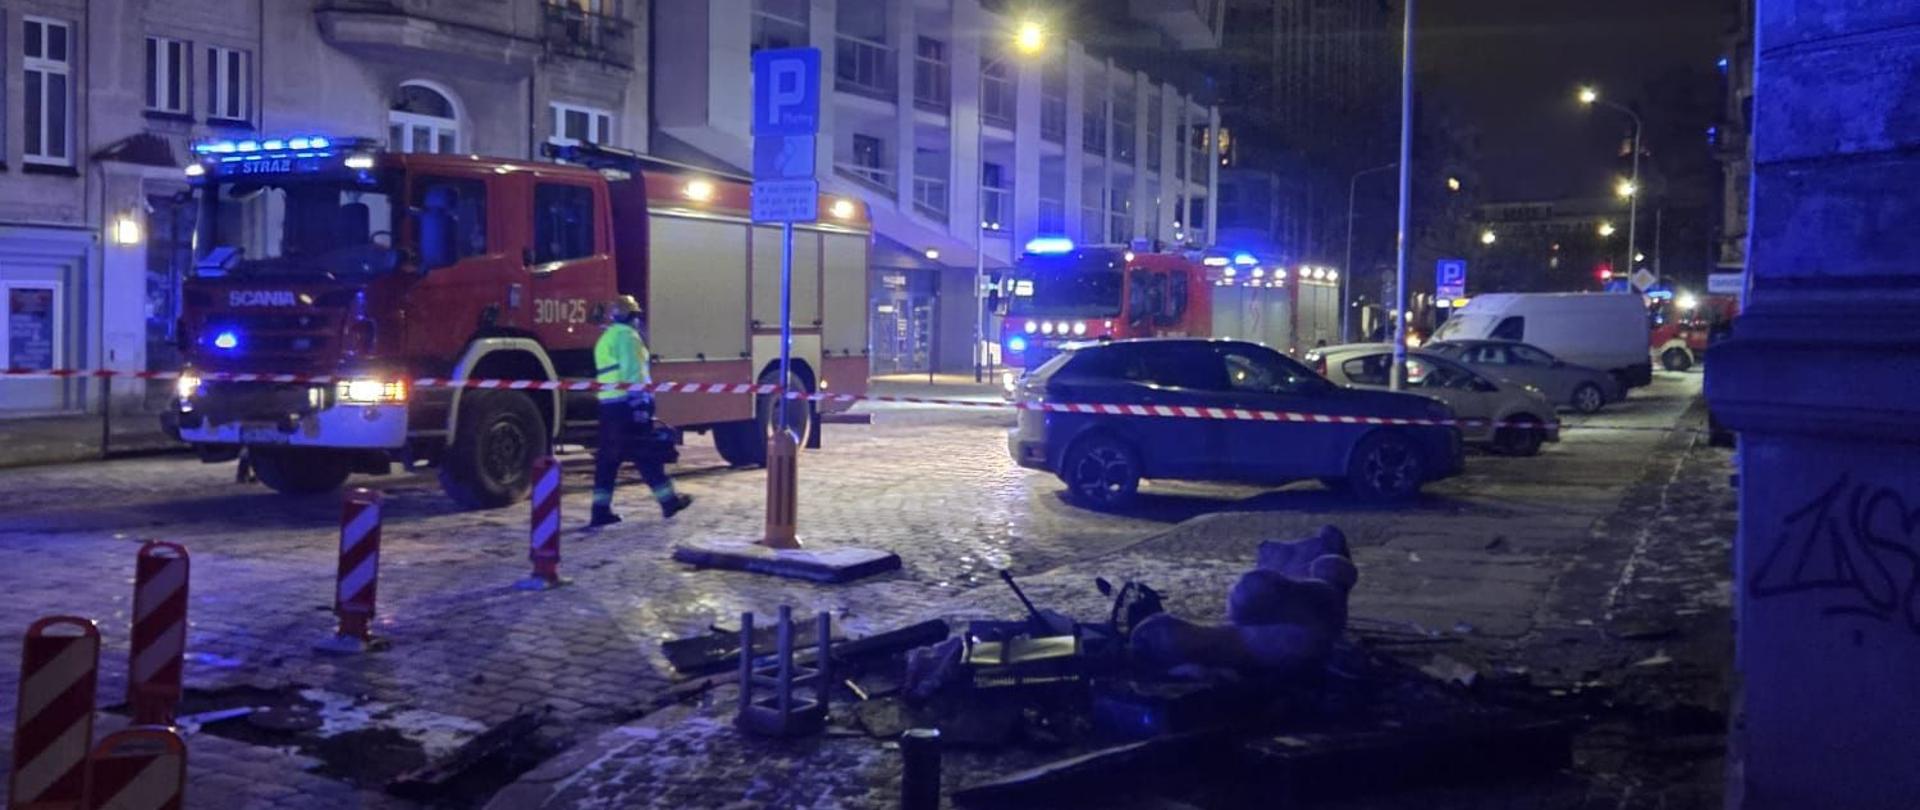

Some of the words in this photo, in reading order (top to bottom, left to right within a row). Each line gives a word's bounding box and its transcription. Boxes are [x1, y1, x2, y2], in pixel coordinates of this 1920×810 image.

[769, 58, 806, 125] P
[1443, 263, 1461, 284] P
[229, 290, 296, 307] SCANIA
